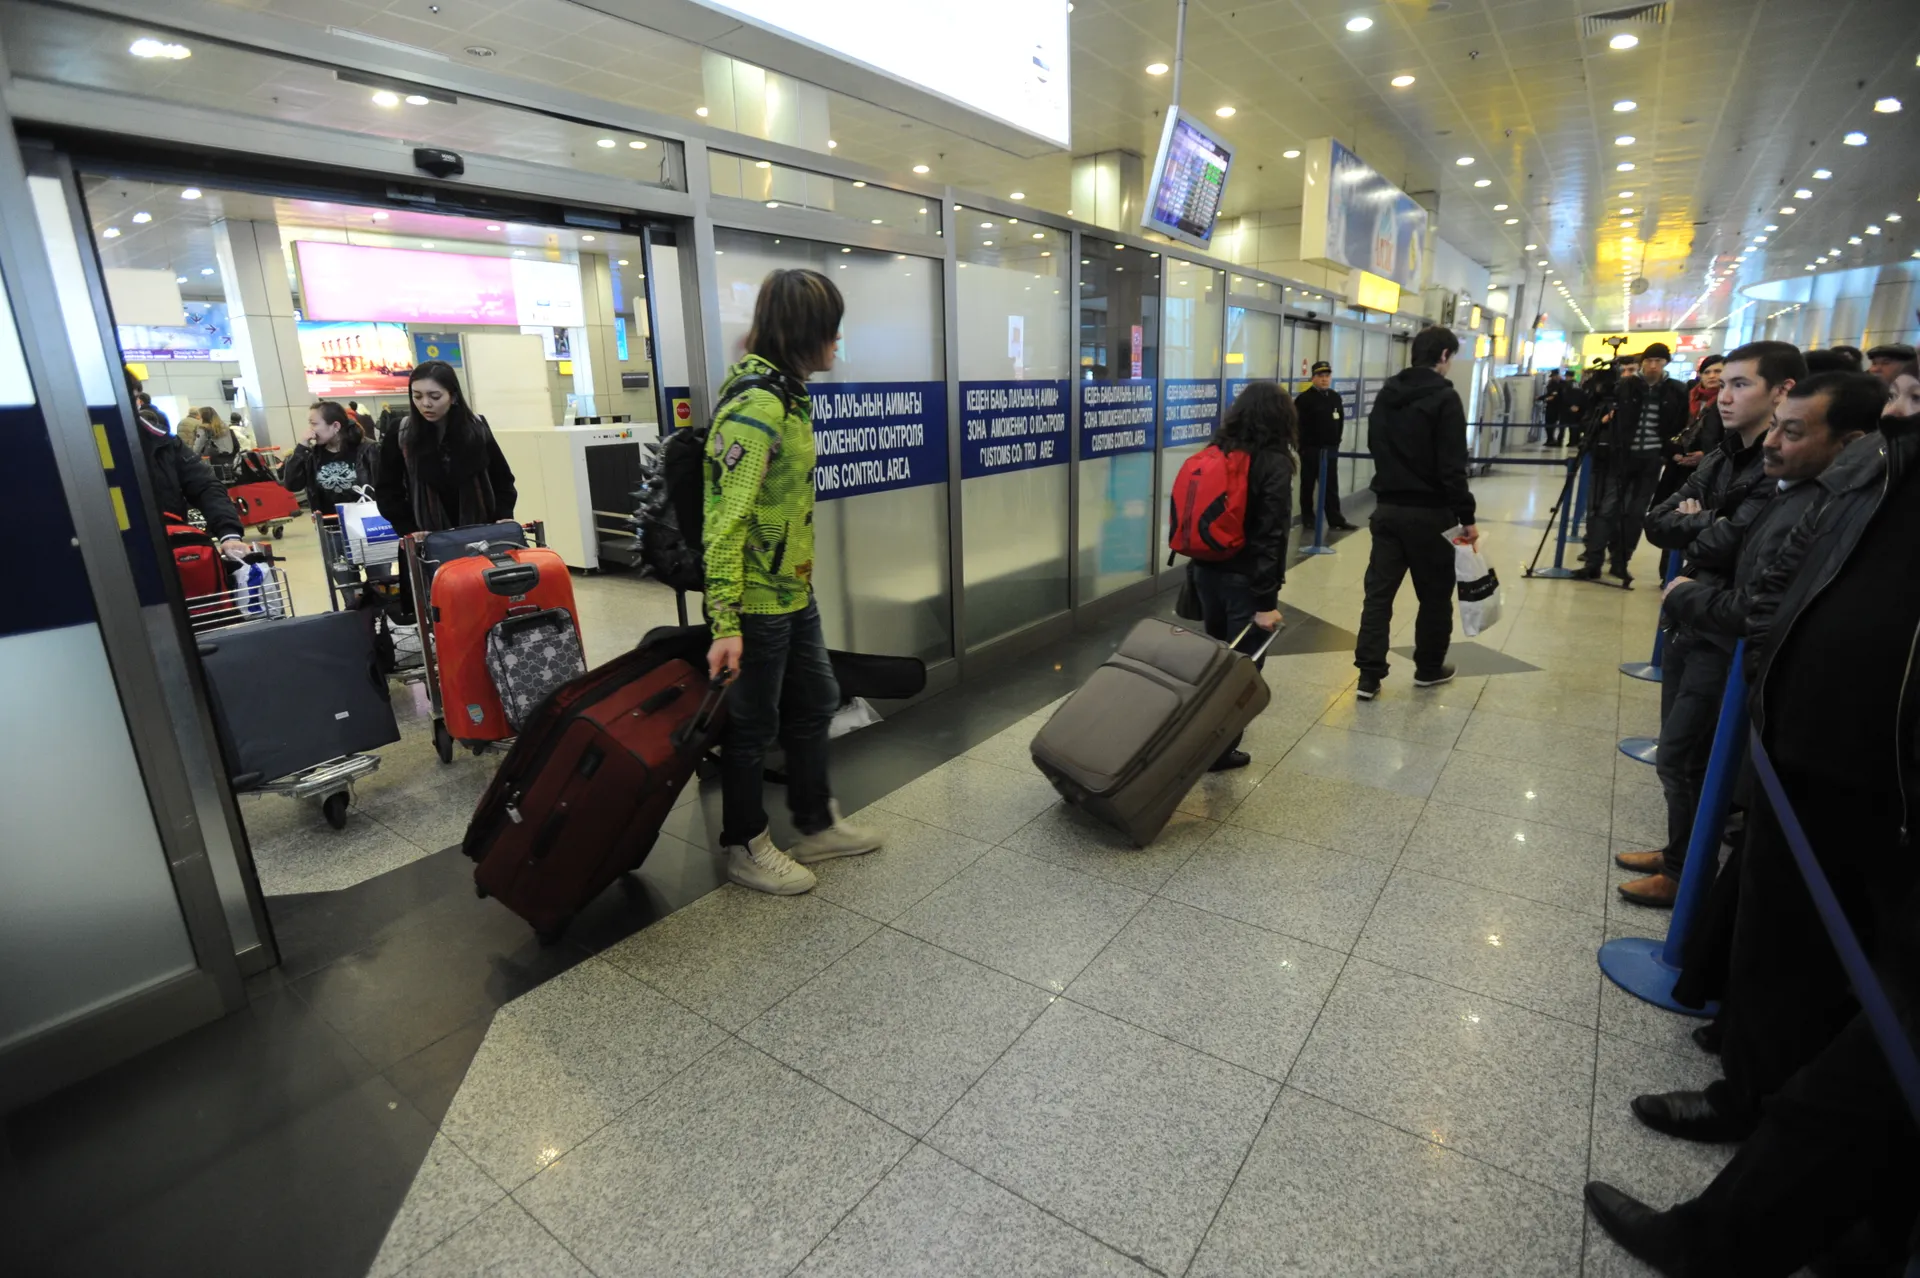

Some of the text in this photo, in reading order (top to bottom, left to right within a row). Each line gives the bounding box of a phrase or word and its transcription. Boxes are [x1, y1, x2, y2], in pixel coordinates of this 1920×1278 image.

[814, 424, 924, 456] МОЖЕННОГО КОНТРОЛЯ
[967, 419, 987, 441] ЗОНА
[814, 464, 840, 492] TOMS
[841, 459, 886, 488] CONTROL
